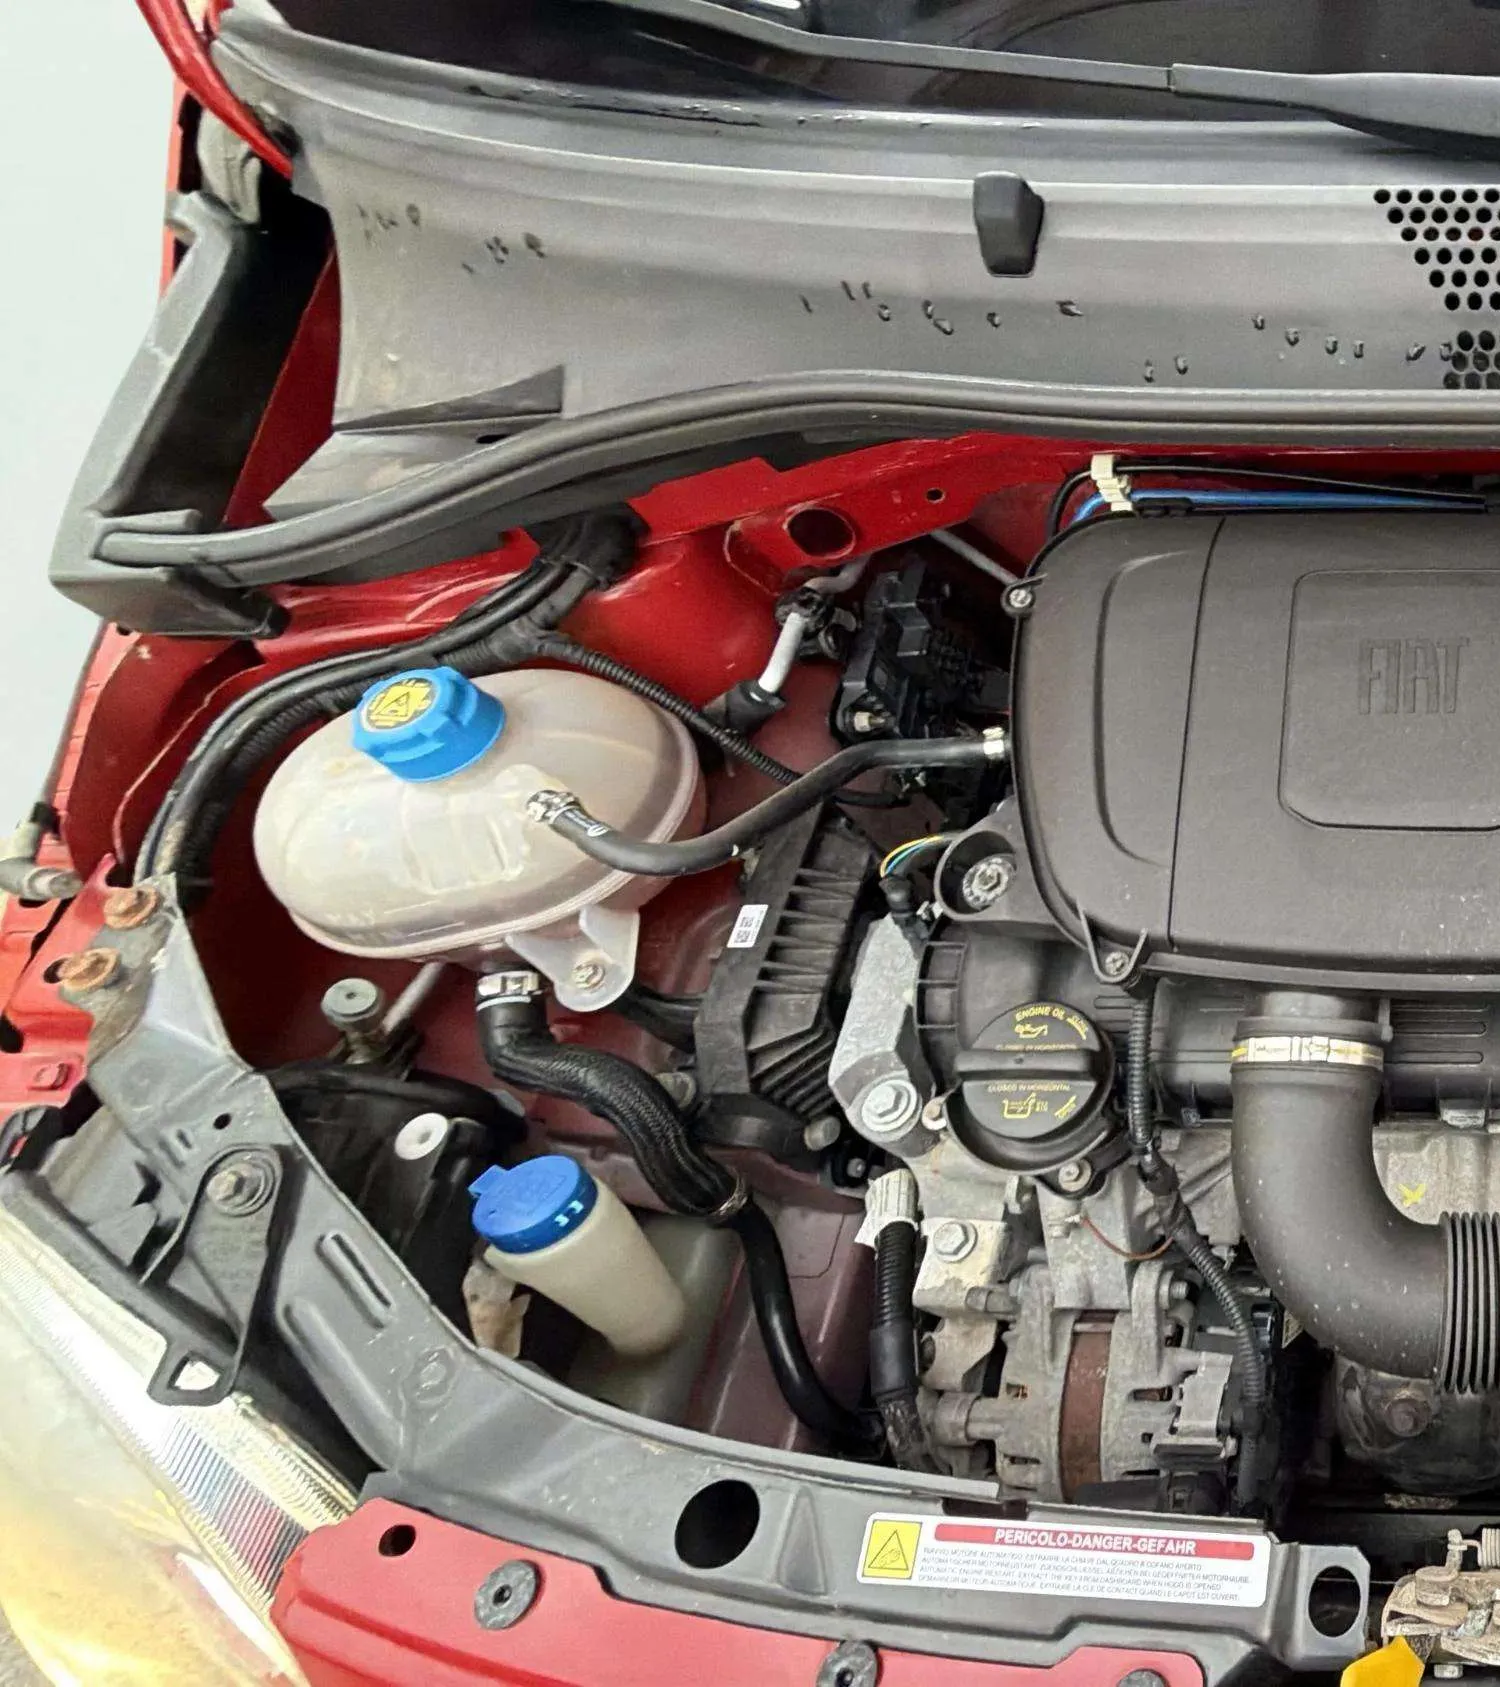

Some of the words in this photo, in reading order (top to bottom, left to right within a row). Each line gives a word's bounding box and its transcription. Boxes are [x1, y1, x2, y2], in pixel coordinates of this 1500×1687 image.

[1358, 638, 1470, 715] FIAT
[1015, 1006, 1051, 1021] ENGINE
[995, 1528, 1197, 1555] PERICOLO-DANGER-GEFAHR
